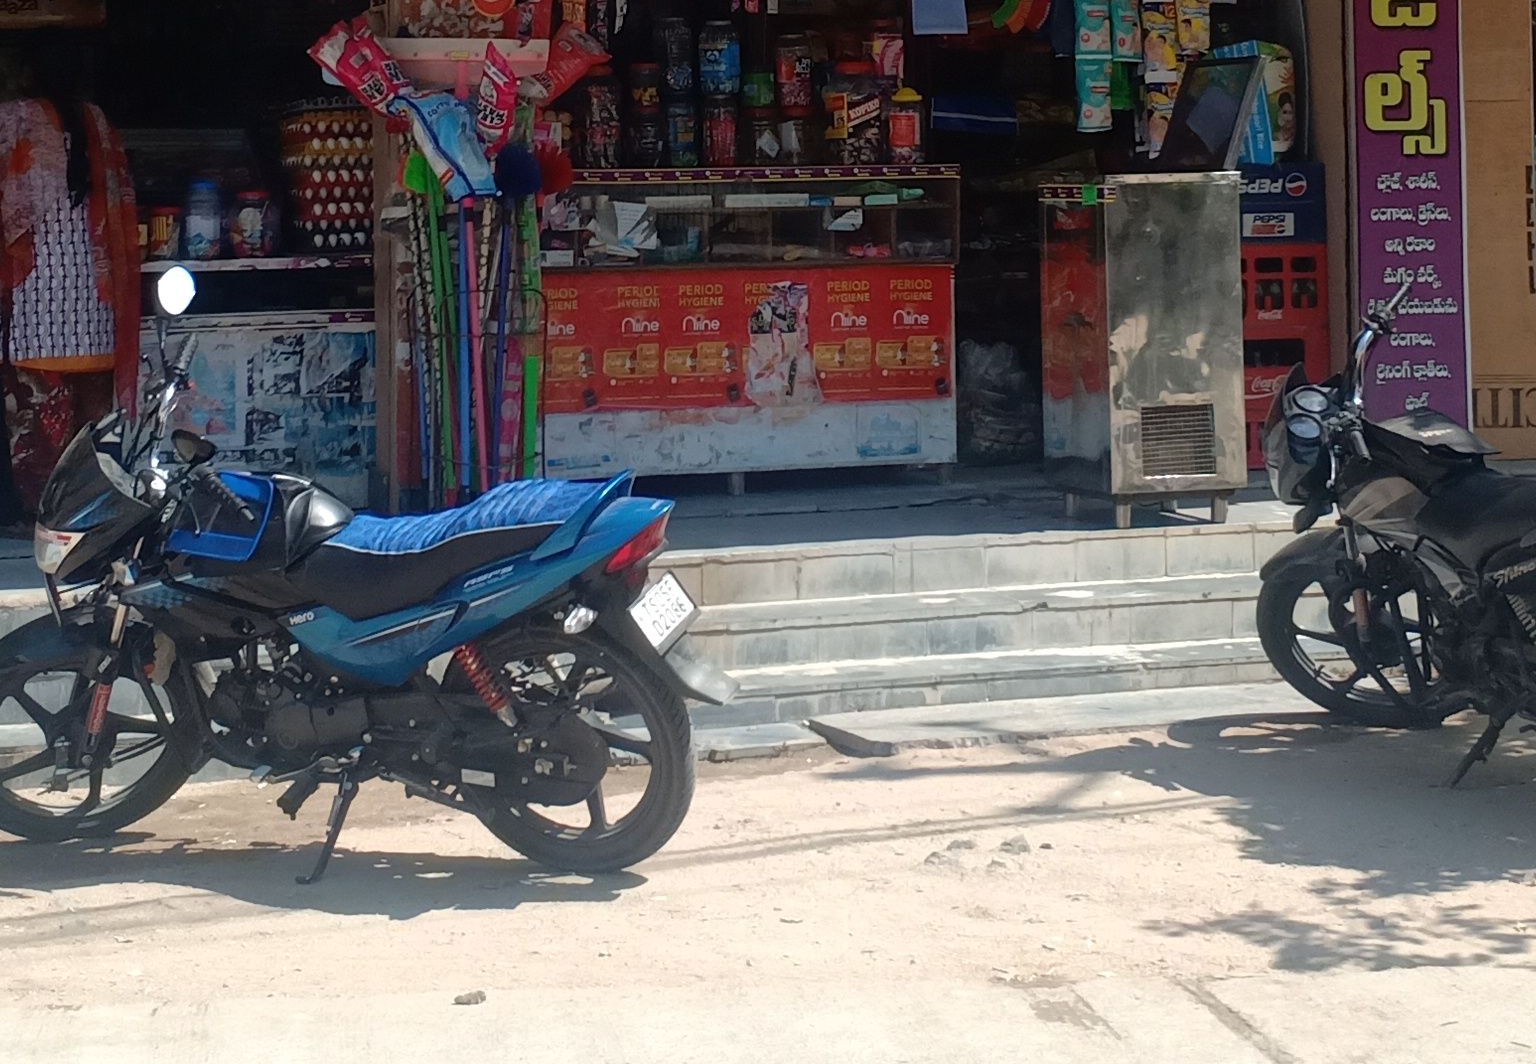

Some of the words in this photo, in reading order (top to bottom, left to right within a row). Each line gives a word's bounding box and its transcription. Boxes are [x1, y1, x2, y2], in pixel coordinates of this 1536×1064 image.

[1253, 215, 1286, 224] PEPSI
[678, 284, 723, 296] PERIOD
[827, 280, 870, 292] PERIOD
[890, 279, 933, 290] PERIOD
[827, 291, 871, 303] HYGIENE
[890, 290, 933, 301] HYGIENE
[678, 296, 724, 307] HYGIENE
